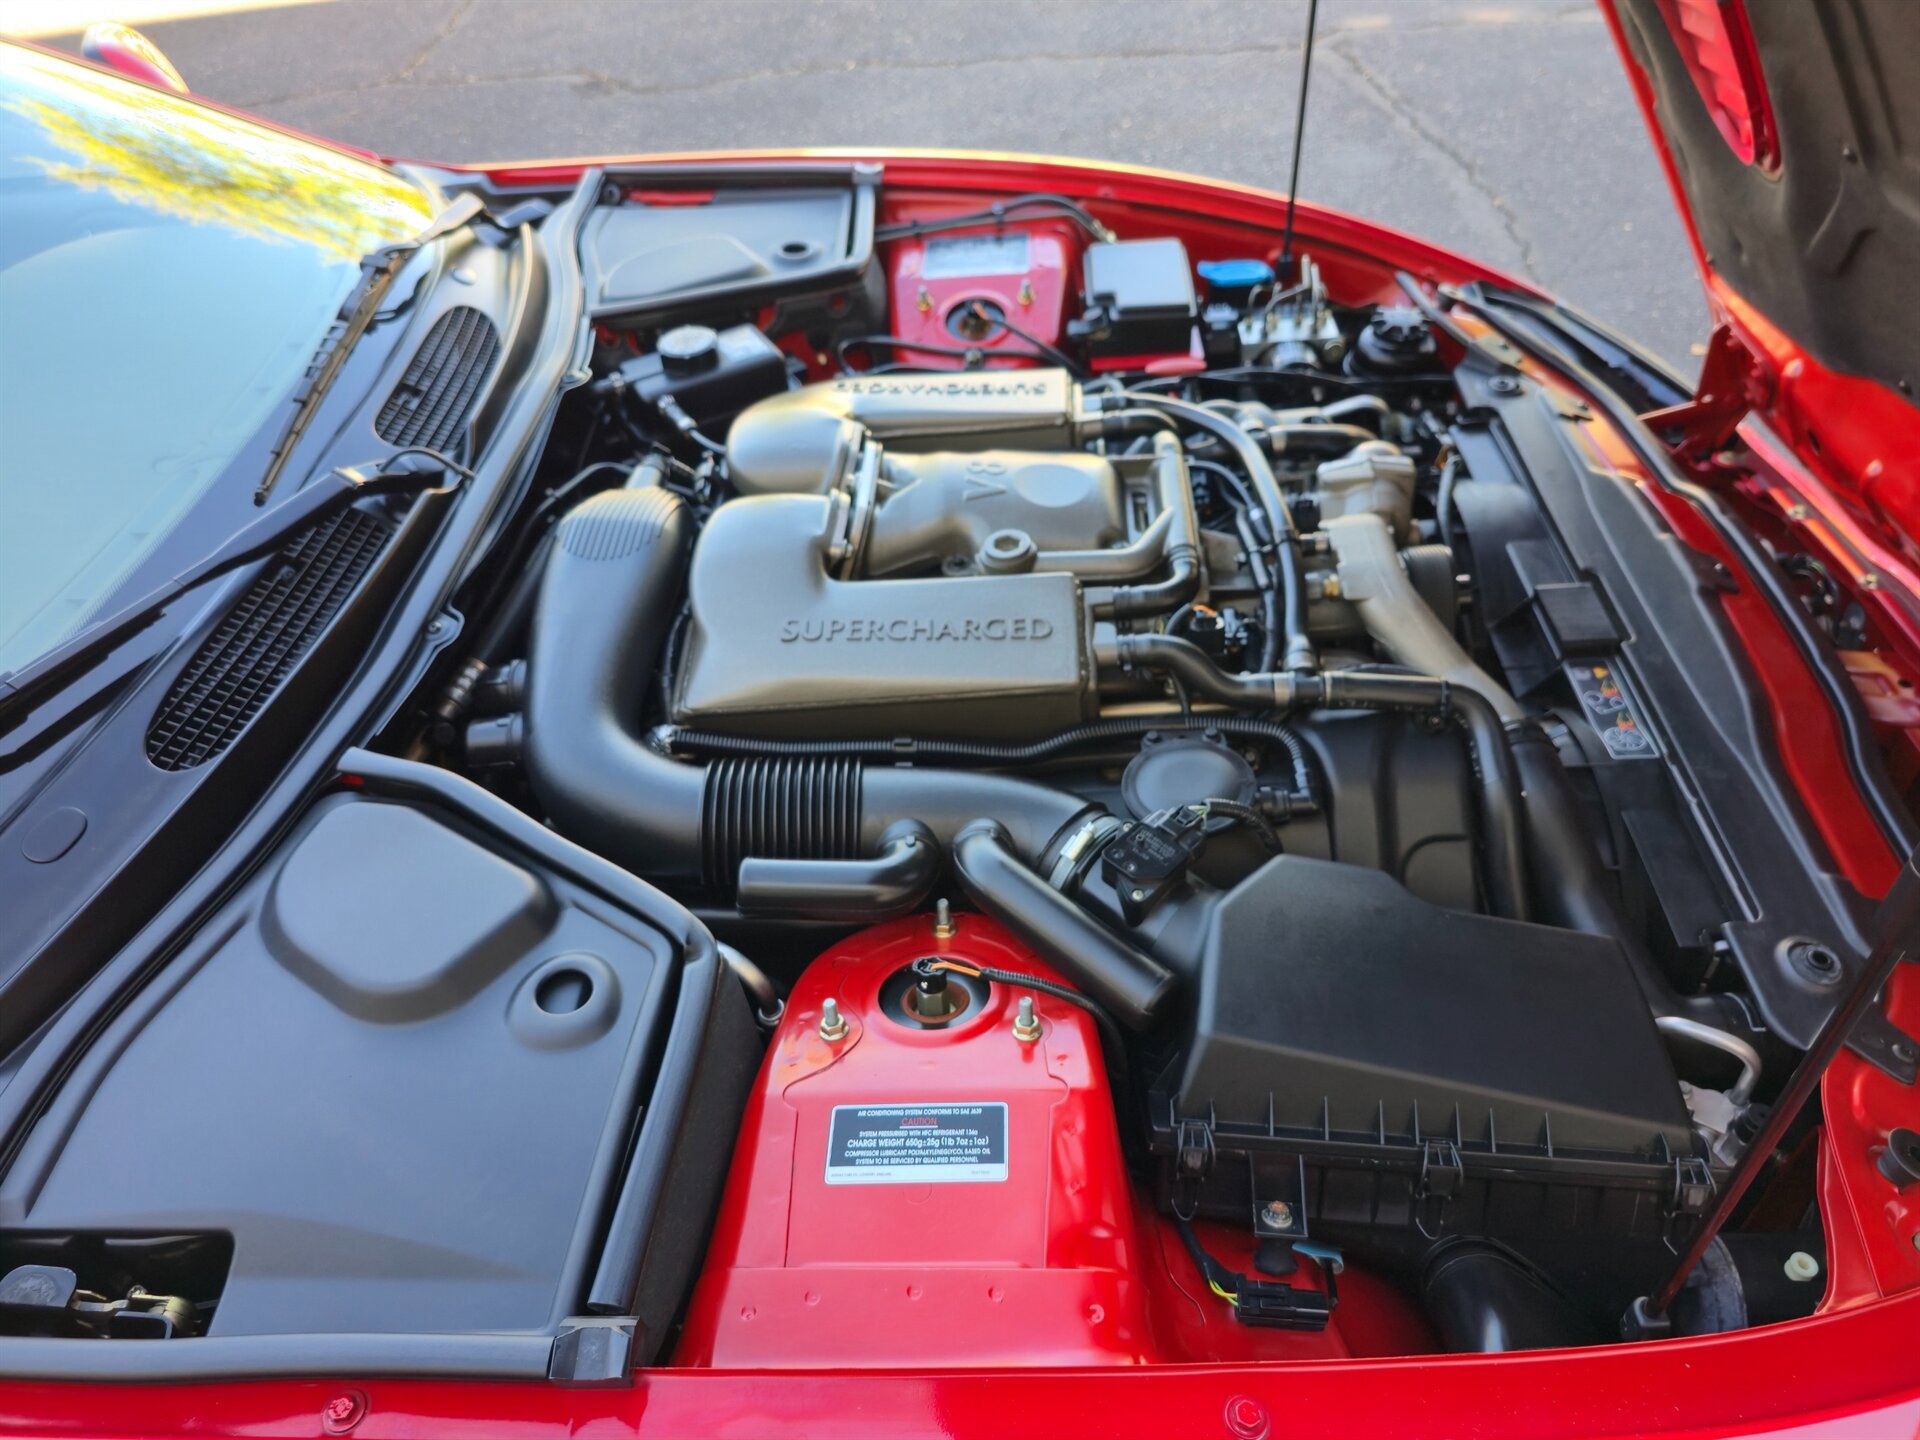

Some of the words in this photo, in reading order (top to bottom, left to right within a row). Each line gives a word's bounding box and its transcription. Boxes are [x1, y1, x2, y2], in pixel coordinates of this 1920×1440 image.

[962, 461, 1008, 502] V8
[780, 617, 1054, 644] SUPERCHARGED
[867, 1109, 904, 1117] CONDITIONING
[900, 1117, 937, 1126] CAUTION
[859, 1130, 878, 1138] SYSTEM
[847, 1139, 877, 1148] CHARGE
[878, 1138, 905, 1147] WEIGHT
[981, 1147, 991, 1155] OIL
[922, 1156, 949, 1164] QUALIFIED
